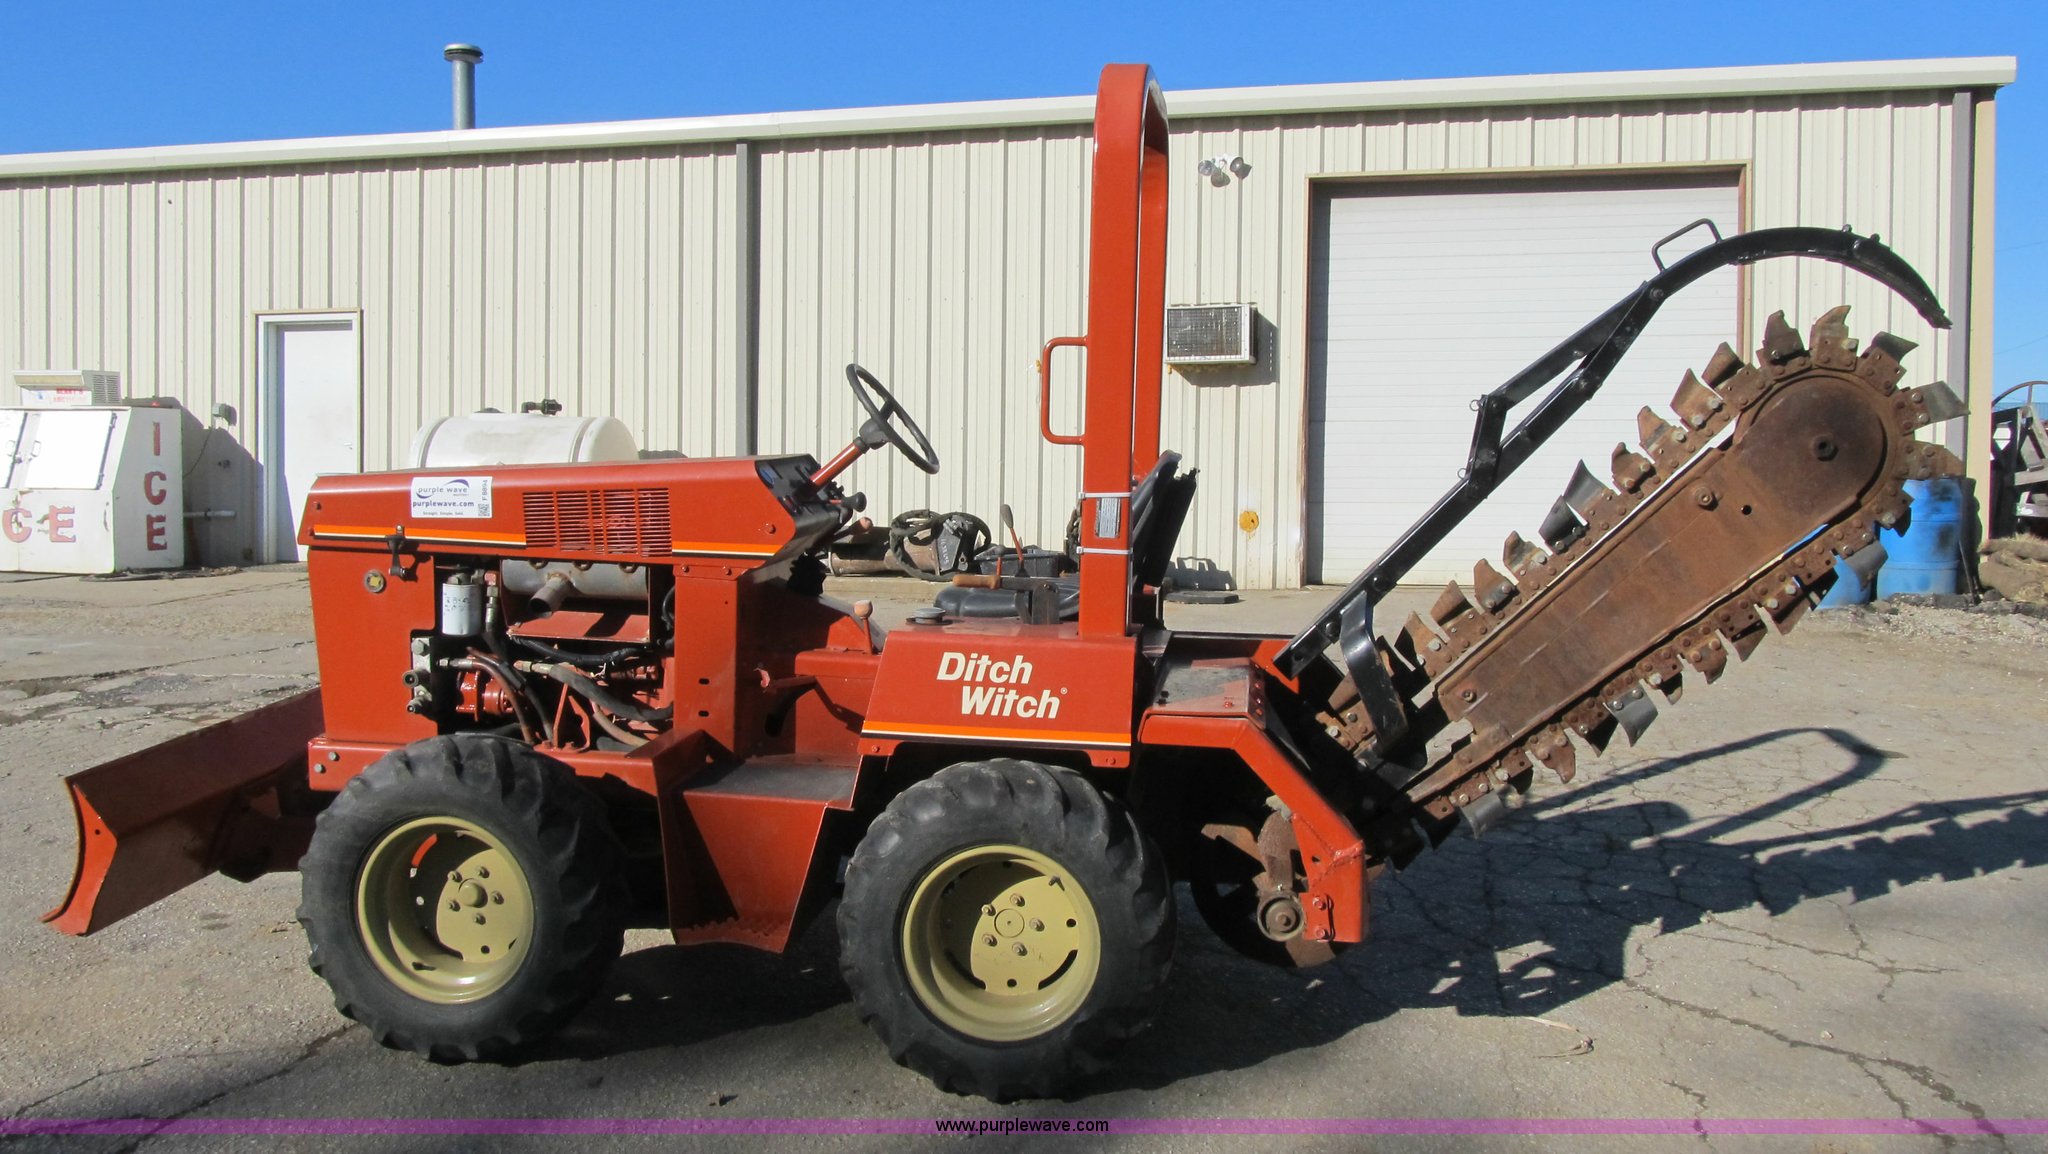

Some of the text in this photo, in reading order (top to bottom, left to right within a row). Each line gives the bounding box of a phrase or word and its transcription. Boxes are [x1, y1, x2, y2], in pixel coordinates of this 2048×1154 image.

[144, 421, 168, 552] ICE
[418, 486, 444, 494] purple
[412, 499, 475, 508] purplewave.com
[936, 651, 1033, 684] Ditch
